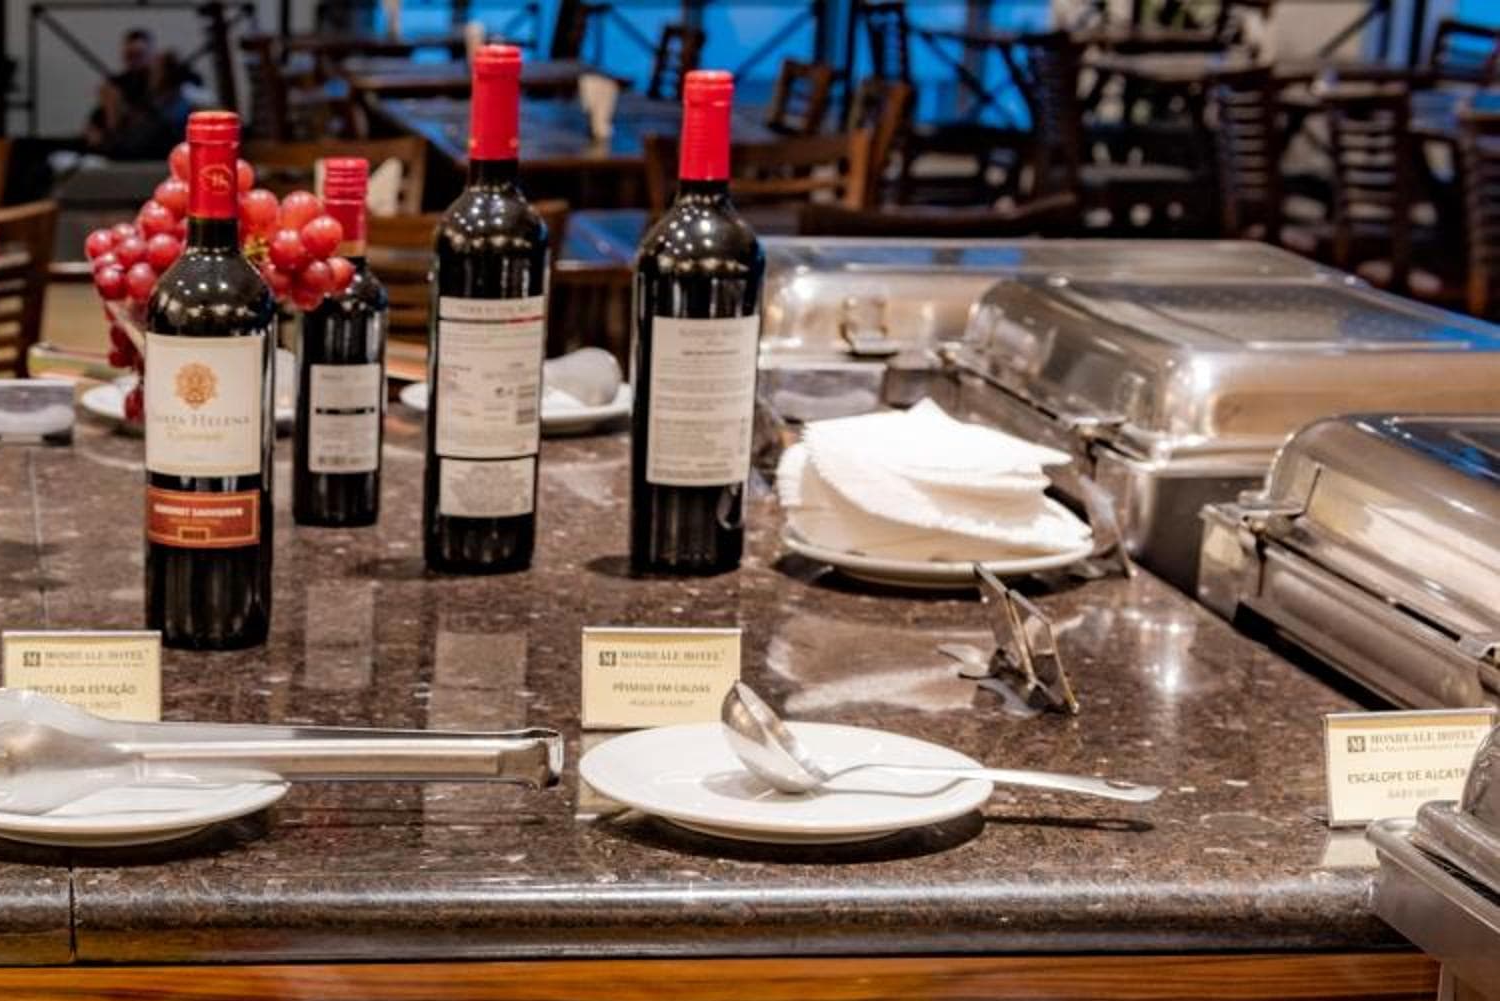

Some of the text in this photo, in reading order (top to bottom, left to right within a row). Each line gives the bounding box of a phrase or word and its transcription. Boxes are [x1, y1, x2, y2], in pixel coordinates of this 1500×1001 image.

[69, 685, 85, 695] DA
[1348, 770, 1401, 784] ESCALOPE
[1406, 770, 1423, 781] DE
